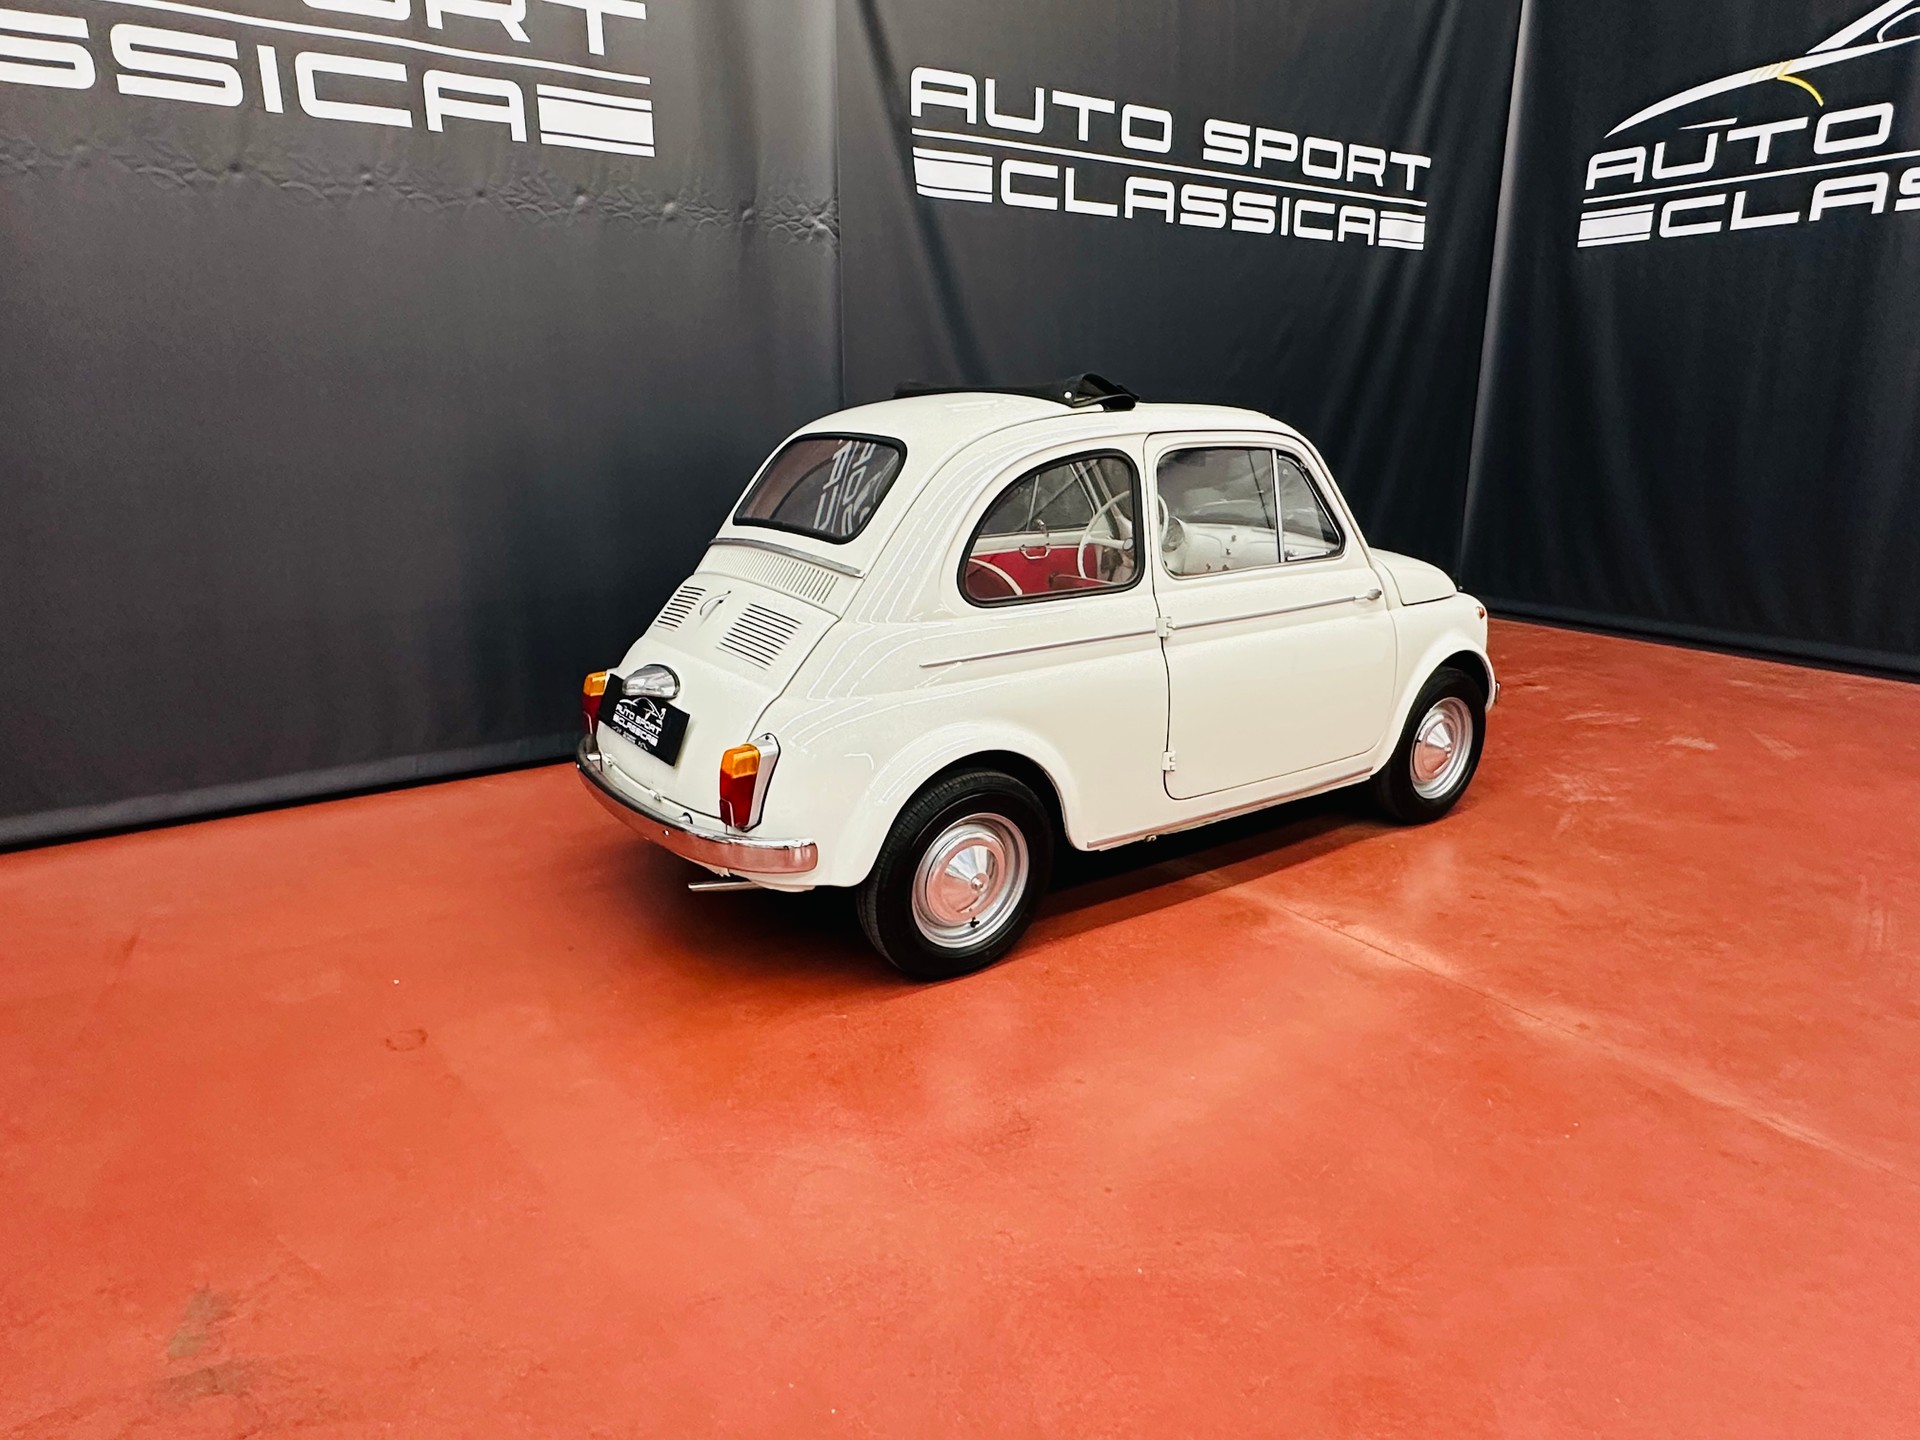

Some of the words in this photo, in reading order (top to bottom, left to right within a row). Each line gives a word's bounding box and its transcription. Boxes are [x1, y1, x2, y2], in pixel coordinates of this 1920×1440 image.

[911, 67, 1172, 153] AUTO
[1203, 119, 1431, 190] SPORT
[1586, 103, 1893, 190] AUTO
[1001, 160, 1375, 245] CLASSICA
[615, 703, 635, 721] AUTO
[635, 715, 662, 735] SPORT
